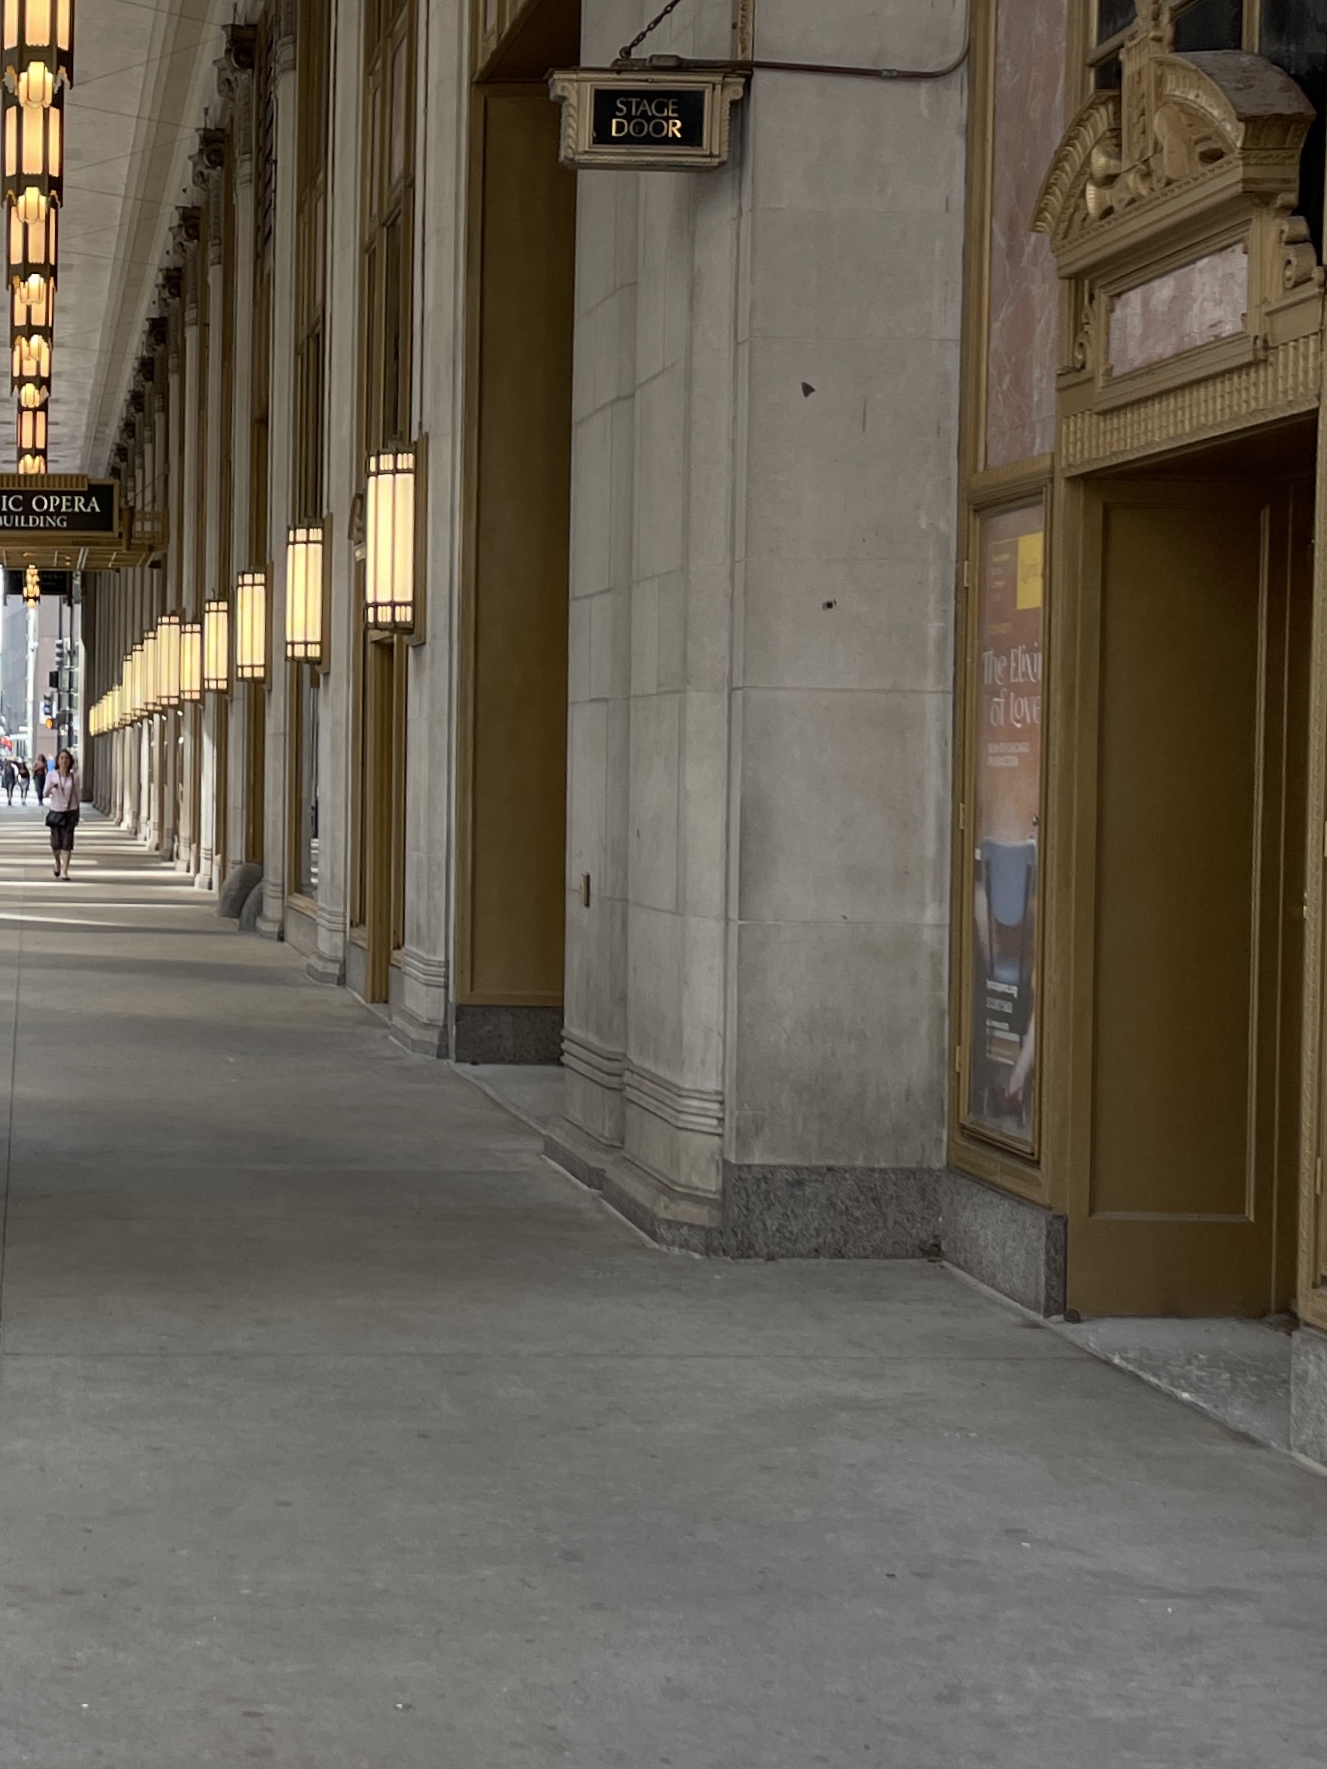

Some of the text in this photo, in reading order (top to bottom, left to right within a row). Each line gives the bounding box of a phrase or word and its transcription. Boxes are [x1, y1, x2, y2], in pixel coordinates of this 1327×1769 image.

[615, 97, 679, 117] STAGE
[611, 118, 682, 138] DOOR
[31, 494, 101, 513] OPERA
[983, 649, 1007, 685] The
[989, 687, 1007, 726] of
